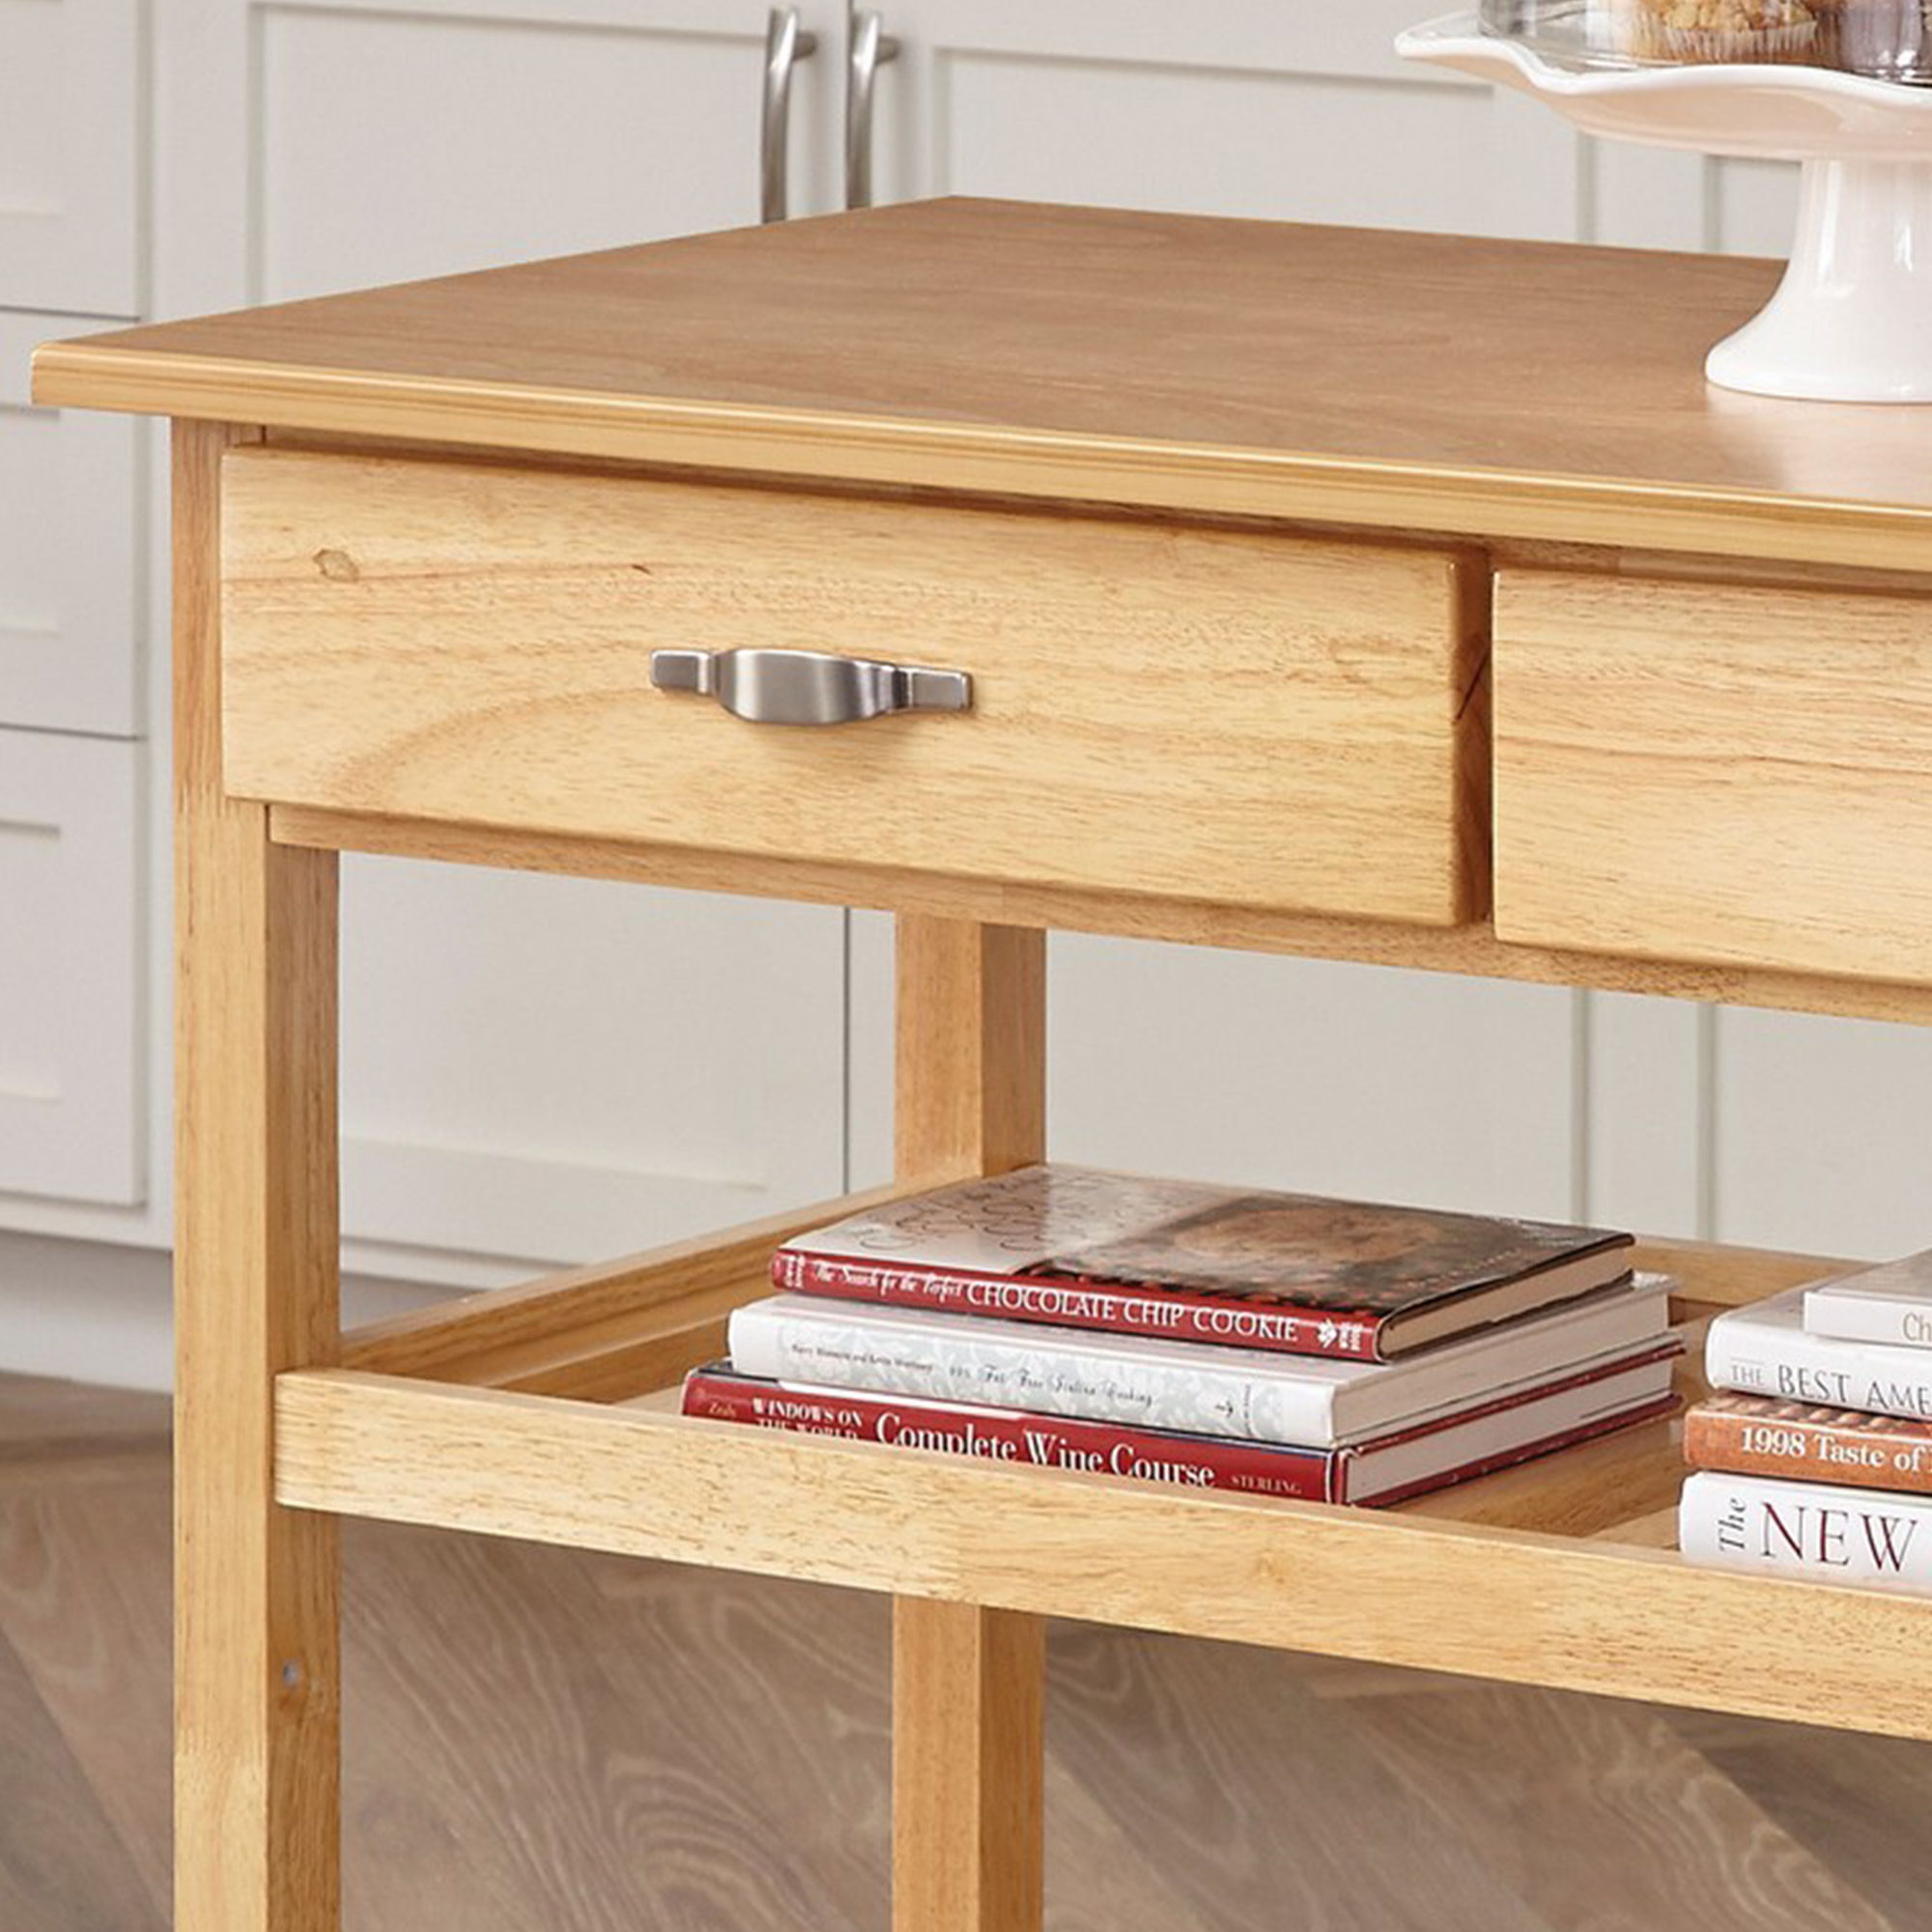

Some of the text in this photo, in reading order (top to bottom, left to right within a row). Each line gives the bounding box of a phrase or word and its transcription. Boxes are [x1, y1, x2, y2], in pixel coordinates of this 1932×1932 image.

[967, 1282, 1117, 1321] CHOCOLATE
[1123, 1298, 1184, 1327] CHIP
[1193, 1307, 1298, 1343] COOKIE
[1730, 1363, 1765, 1387] THE
[1778, 1364, 1852, 1404] BEST
[752, 1397, 863, 1428] WINDOWS ON
[875, 1411, 1216, 1489] Complete Wine Course
[1740, 1425, 1926, 1473] 1998 Taste of
[1230, 1474, 1303, 1496] STERLING
[1719, 1497, 1918, 1574] The NEW
